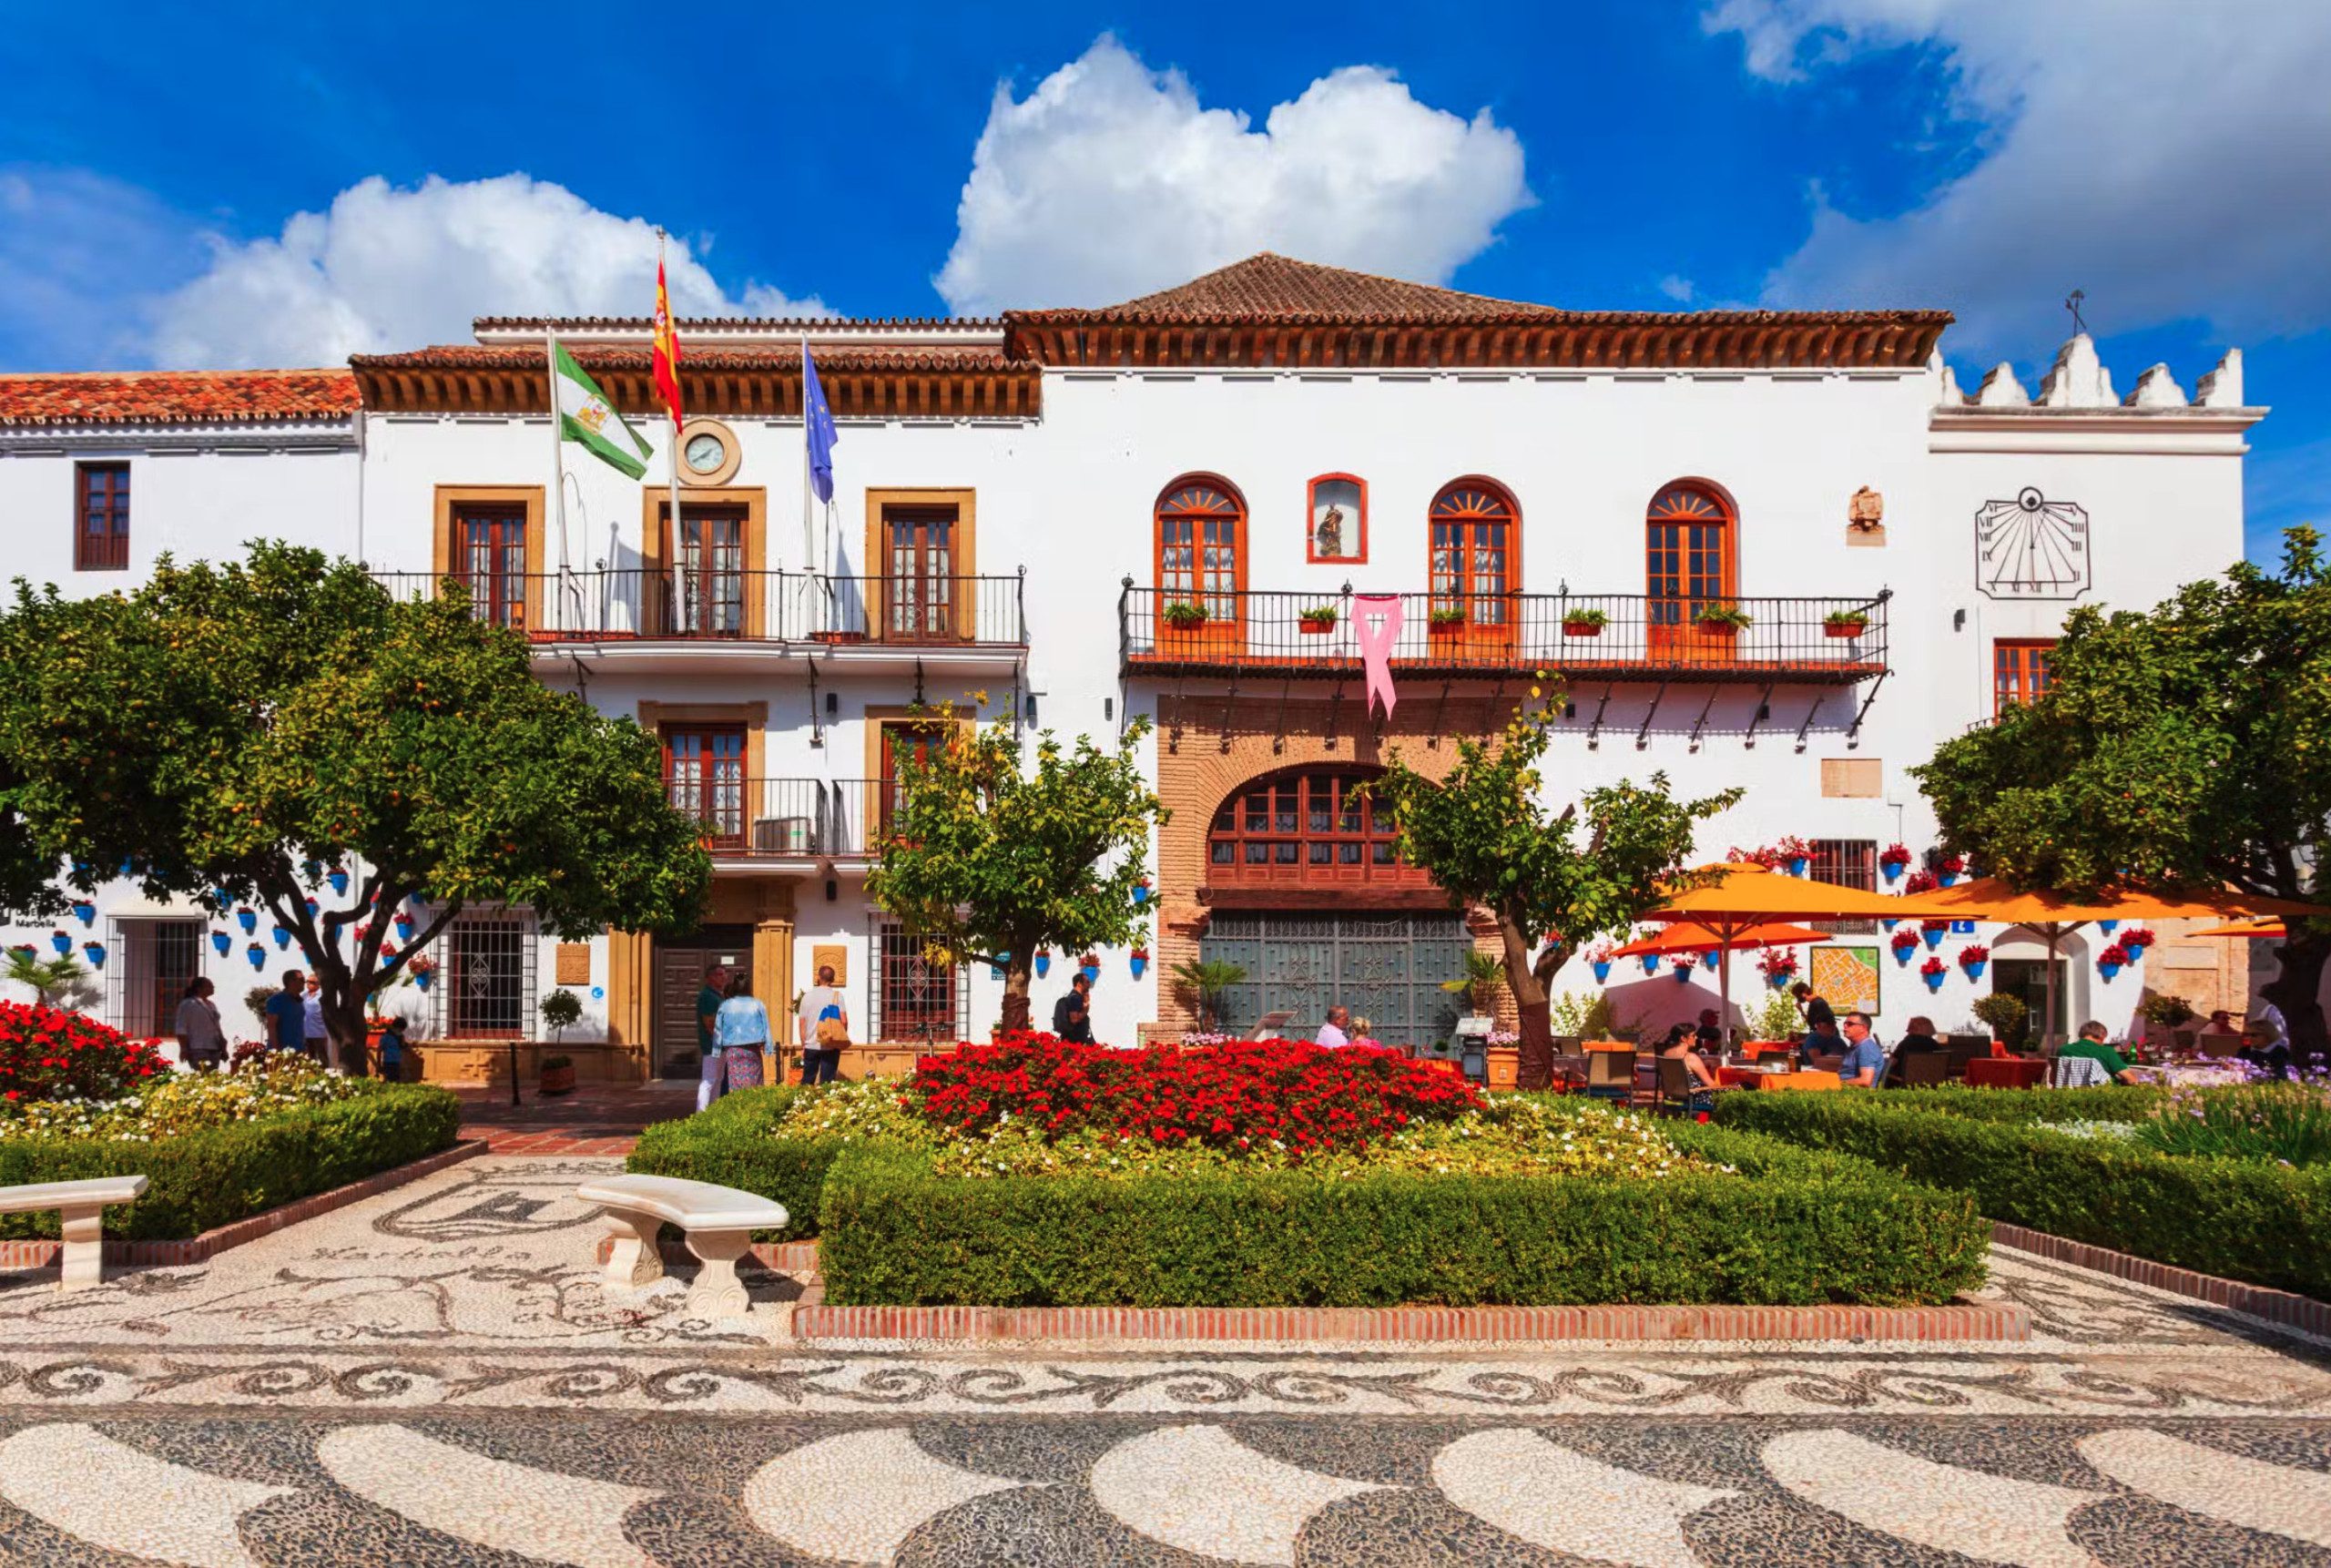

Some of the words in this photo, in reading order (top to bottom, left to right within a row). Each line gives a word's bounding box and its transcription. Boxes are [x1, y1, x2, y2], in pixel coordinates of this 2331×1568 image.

[1979, 516, 1993, 527] VII
[2071, 523, 2084, 533] IIII
[2071, 541, 2082, 551] III
[1982, 550, 1992, 562] IX
[2029, 582, 2041, 593] XII
[15, 919, 56, 927] Marbella
